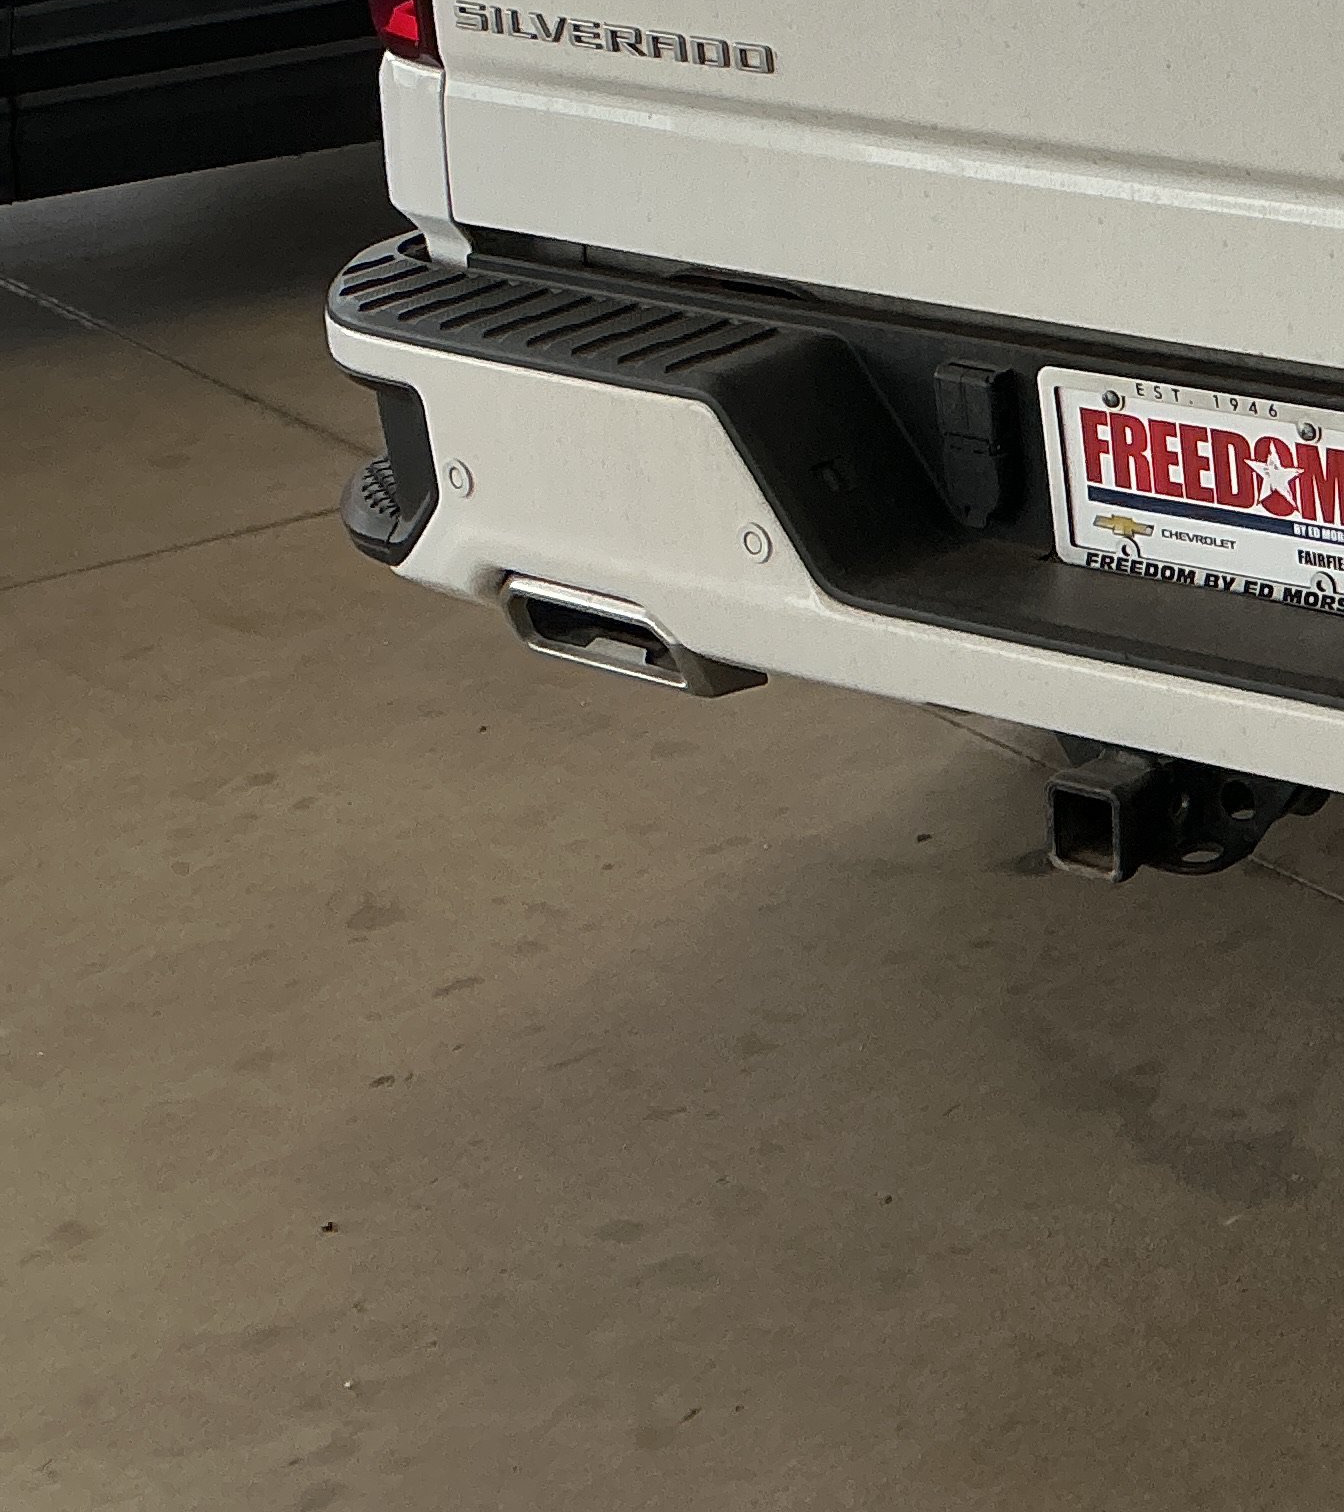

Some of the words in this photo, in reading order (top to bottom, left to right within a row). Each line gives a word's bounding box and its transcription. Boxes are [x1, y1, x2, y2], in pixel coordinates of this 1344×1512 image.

[454, 0, 776, 74] SILVERADO
[1135, 382, 1194, 405] EST.
[1212, 394, 1278, 418] 1946
[1161, 528, 1237, 550] CHEVROLET
[1293, 522, 1307, 536] BY
[1307, 525, 1321, 539] ED
[1085, 552, 1196, 586] FREEDOM
[1203, 572, 1236, 592] BY
[1243, 580, 1275, 599] ED
